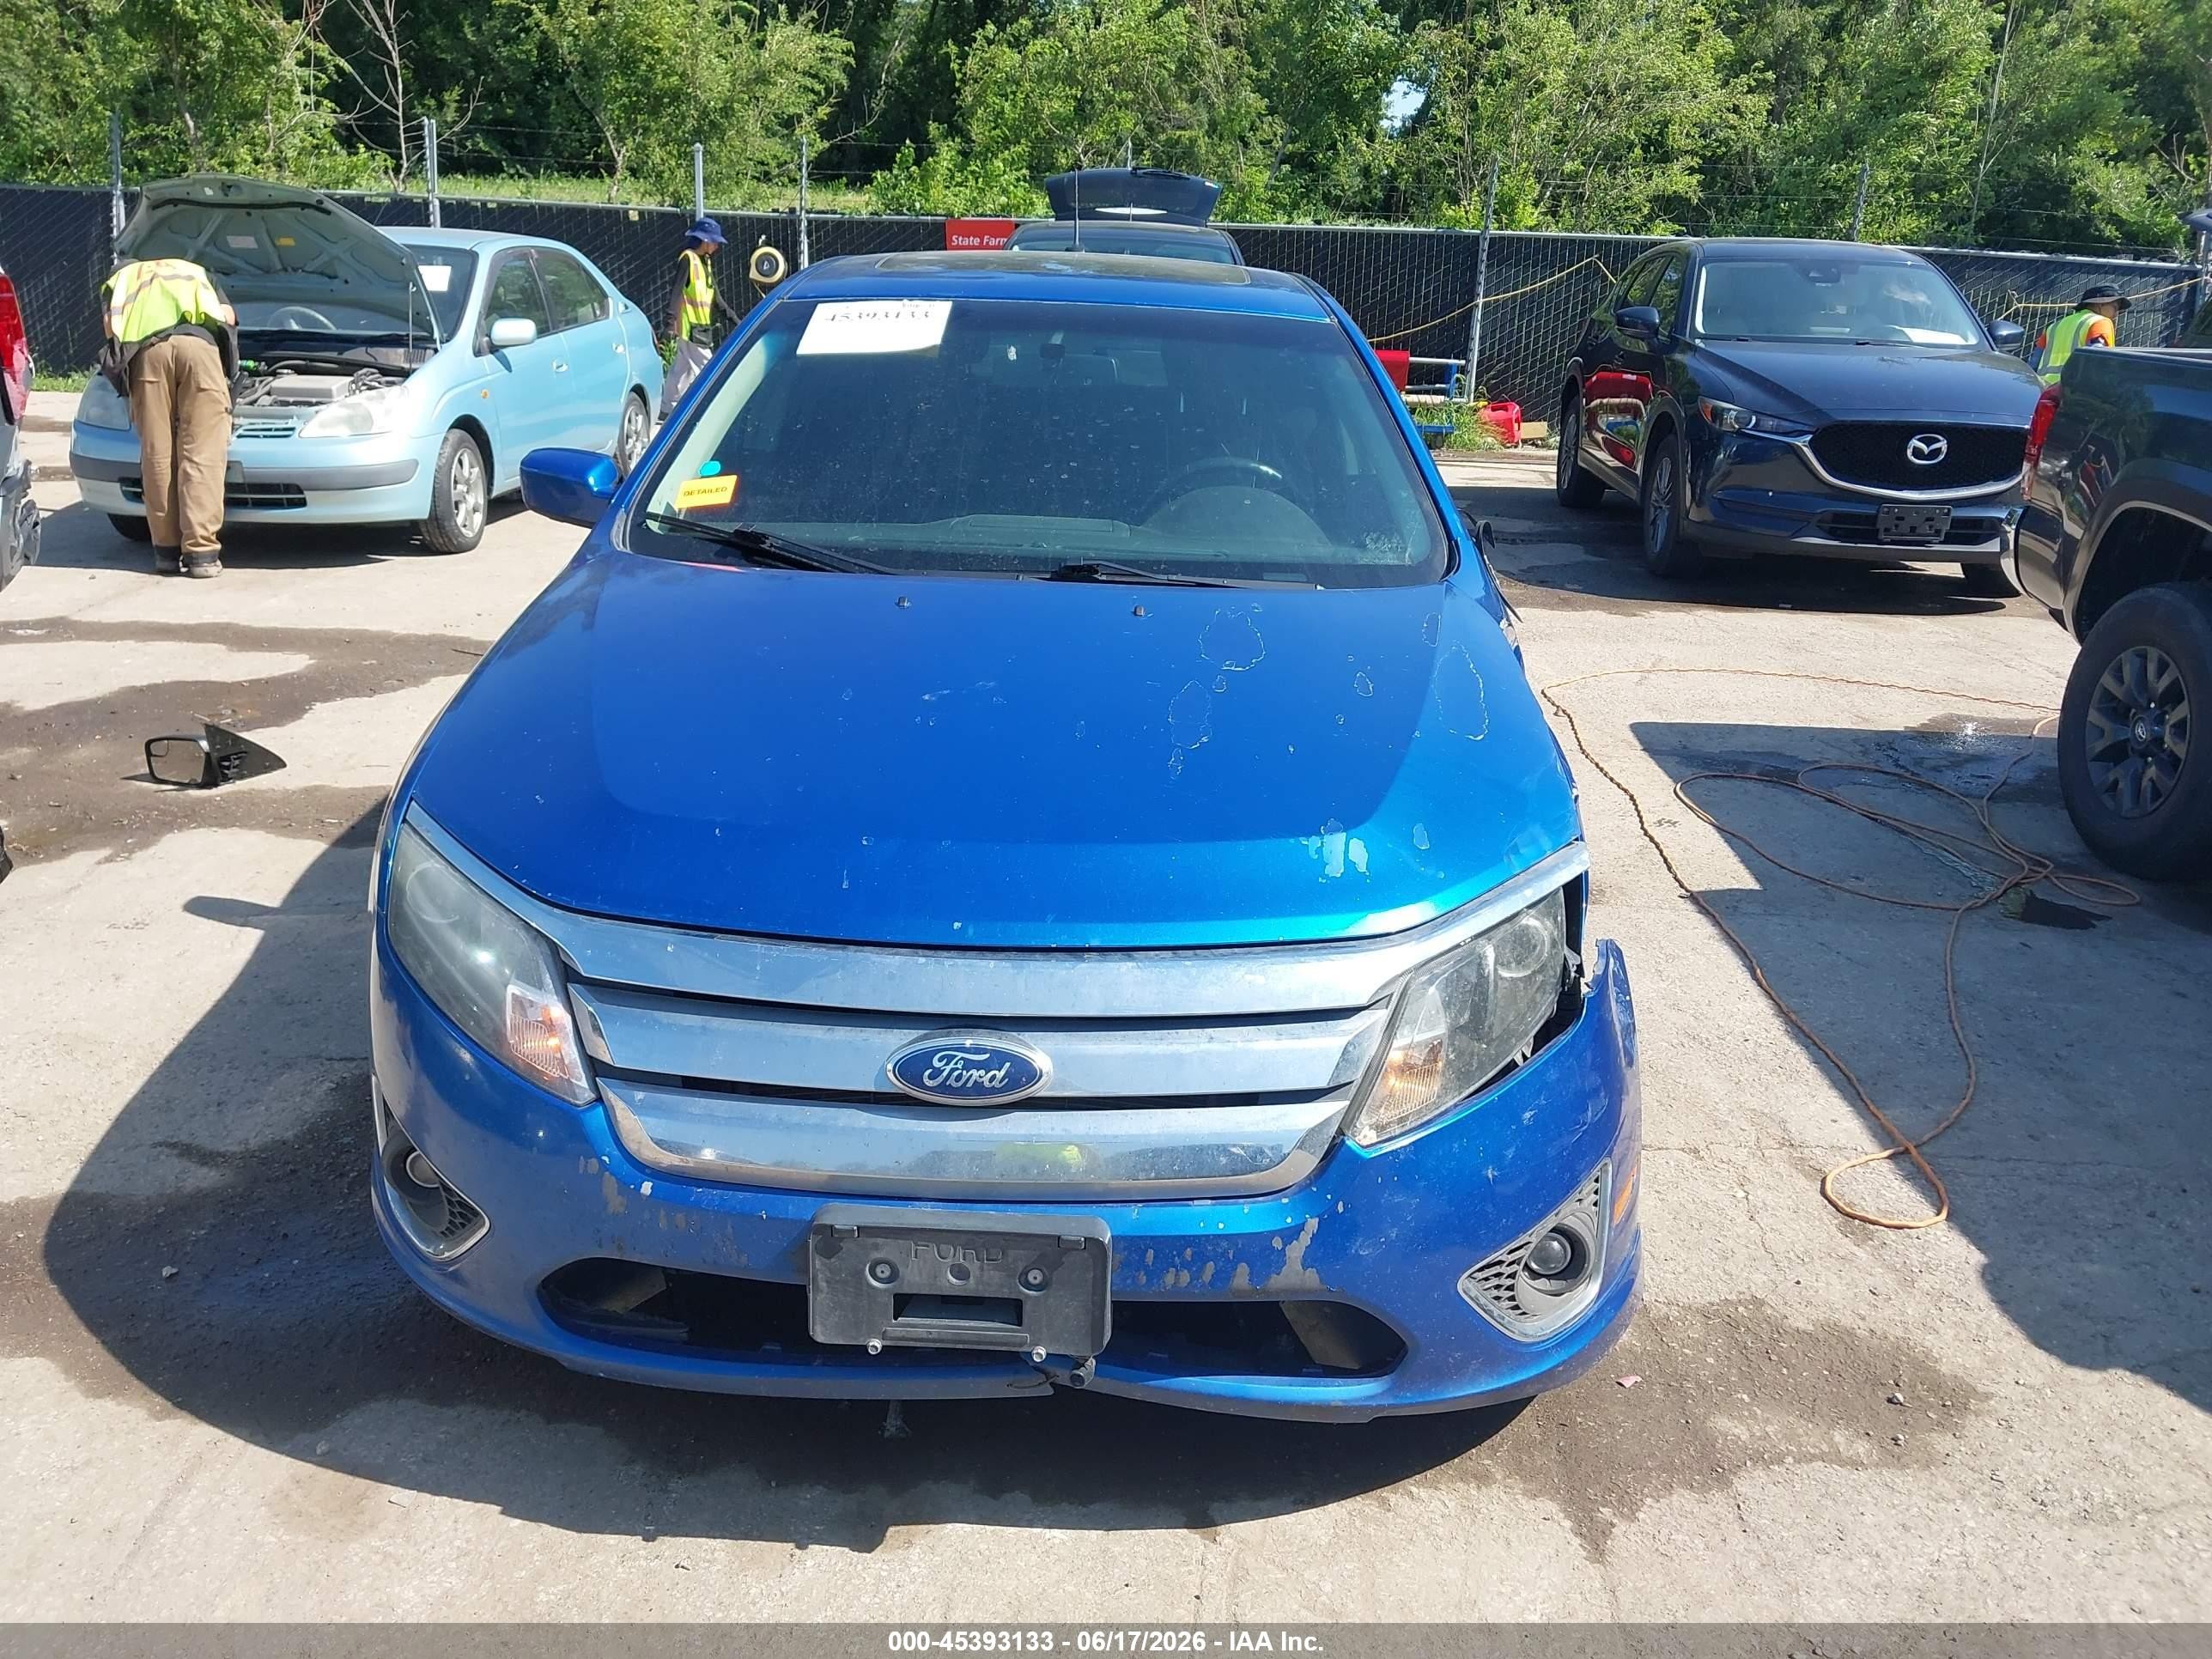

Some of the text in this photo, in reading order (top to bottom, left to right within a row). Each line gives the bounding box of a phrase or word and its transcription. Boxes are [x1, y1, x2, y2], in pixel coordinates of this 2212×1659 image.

[951, 235, 981, 246] State
[684, 487, 728, 496] DETAILED
[923, 1051, 1012, 1089] Ford
